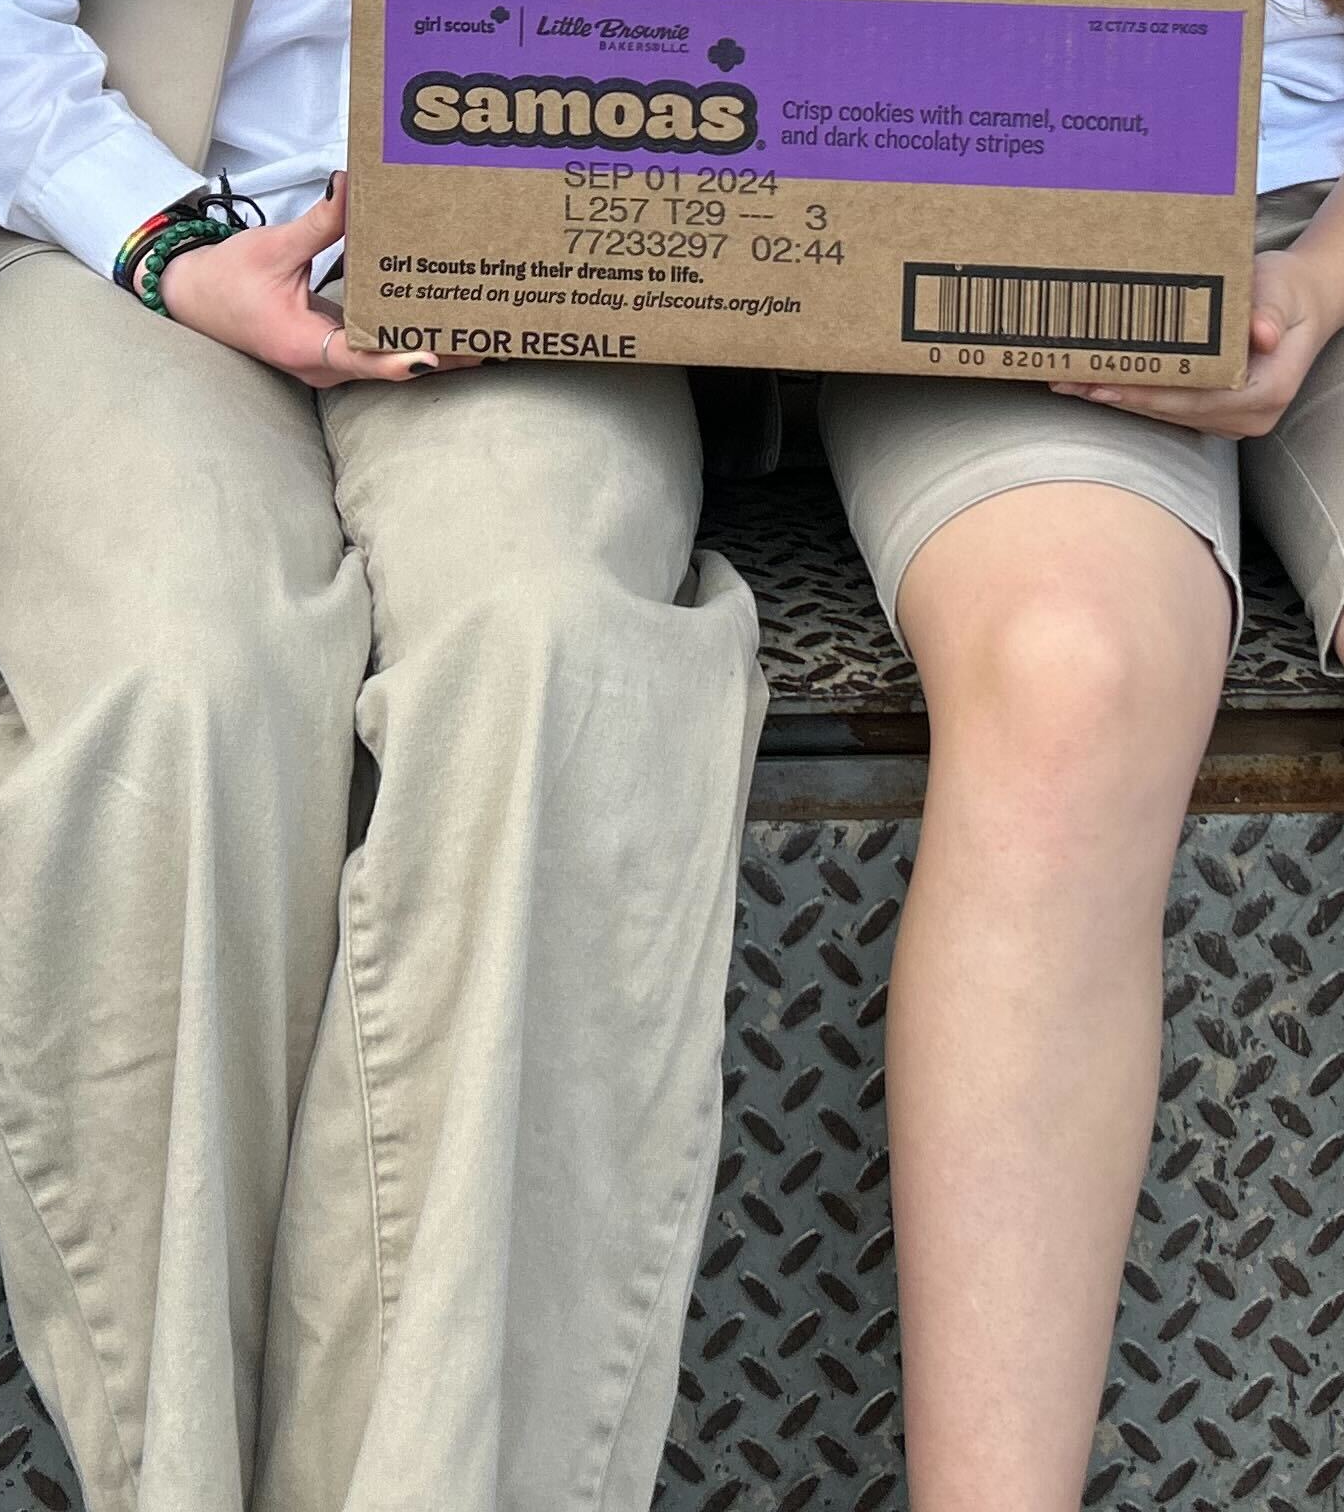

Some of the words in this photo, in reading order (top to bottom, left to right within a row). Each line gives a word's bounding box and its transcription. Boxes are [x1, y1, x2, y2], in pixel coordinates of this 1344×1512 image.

[414, 16, 440, 35] girl
[444, 18, 496, 34] scouts
[537, 15, 592, 38] Little
[595, 17, 689, 40] Brownie
[1087, 20, 1103, 32] 12
[1150, 22, 1169, 34] OZ
[1171, 23, 1209, 35] PKGS
[406, 77, 752, 149] samoas
[782, 99, 832, 125] Crisp
[838, 101, 914, 124] cookies
[920, 104, 962, 125] with
[968, 106, 1055, 133] caramel,
[1061, 111, 1149, 136] coconut,
[781, 126, 818, 147] and
[824, 128, 869, 150] dark
[874, 129, 969, 157] chocolaty
[975, 133, 1045, 158] stripes
[564, 161, 634, 190] SEP
[646, 165, 683, 193] 01
[696, 167, 779, 196] 2024
[664, 197, 726, 226] T29
[805, 204, 828, 232] 3
[563, 228, 729, 260] 77233297
[751, 235, 845, 266] 02:44
[379, 255, 412, 274] Girl
[416, 257, 476, 276] Scouts
[480, 259, 526, 282] bring
[530, 261, 573, 279] their
[576, 263, 643, 283] dreams
[648, 266, 666, 283] to
[670, 265, 705, 285] life.
[379, 283, 412, 301] Get
[416, 283, 482, 303] started
[486, 288, 510, 304] on
[512, 289, 567, 308] yours
[570, 288, 628, 311] today.
[633, 291, 801, 316] girlscouts.org/join
[377, 325, 442, 352] NOT
[450, 328, 512, 355] FOR
[520, 331, 637, 359] RESALE
[929, 346, 941, 364] 0
[958, 348, 985, 366] 00
[1002, 350, 1071, 369] 82011
[1090, 354, 1161, 373] 04000
[1178, 358, 1191, 375] 8
